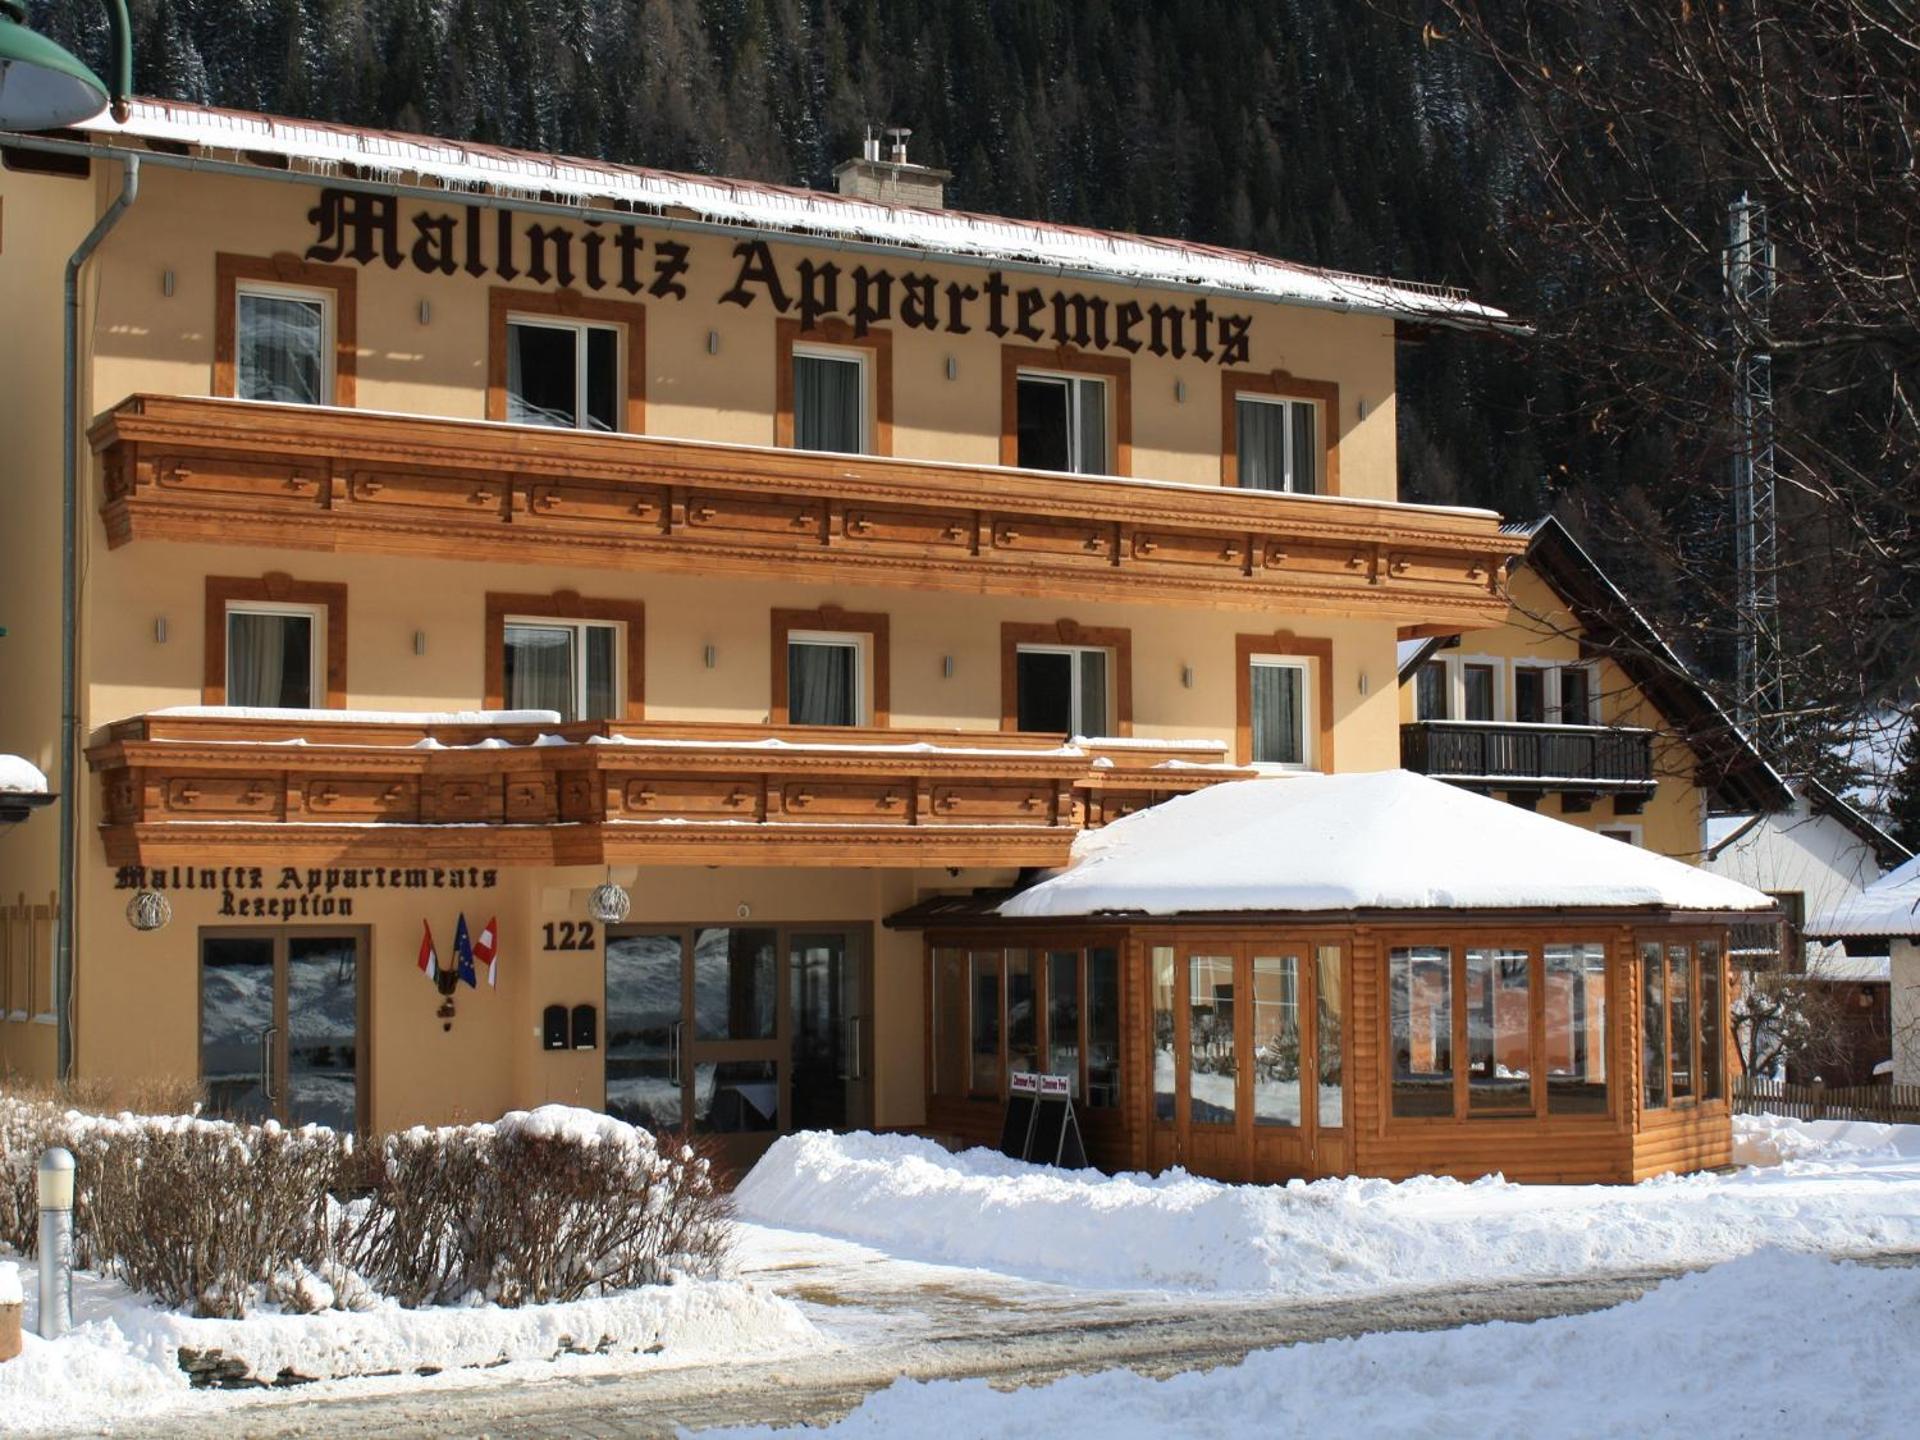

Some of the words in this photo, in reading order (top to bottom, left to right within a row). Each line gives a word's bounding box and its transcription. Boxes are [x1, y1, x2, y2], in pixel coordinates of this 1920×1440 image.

[304, 188, 691, 302] Mallnitz
[717, 238, 1254, 366] Appartements
[114, 864, 263, 890] Mallnitz
[218, 889, 353, 922] Rezeption
[542, 920, 596, 951] 122
